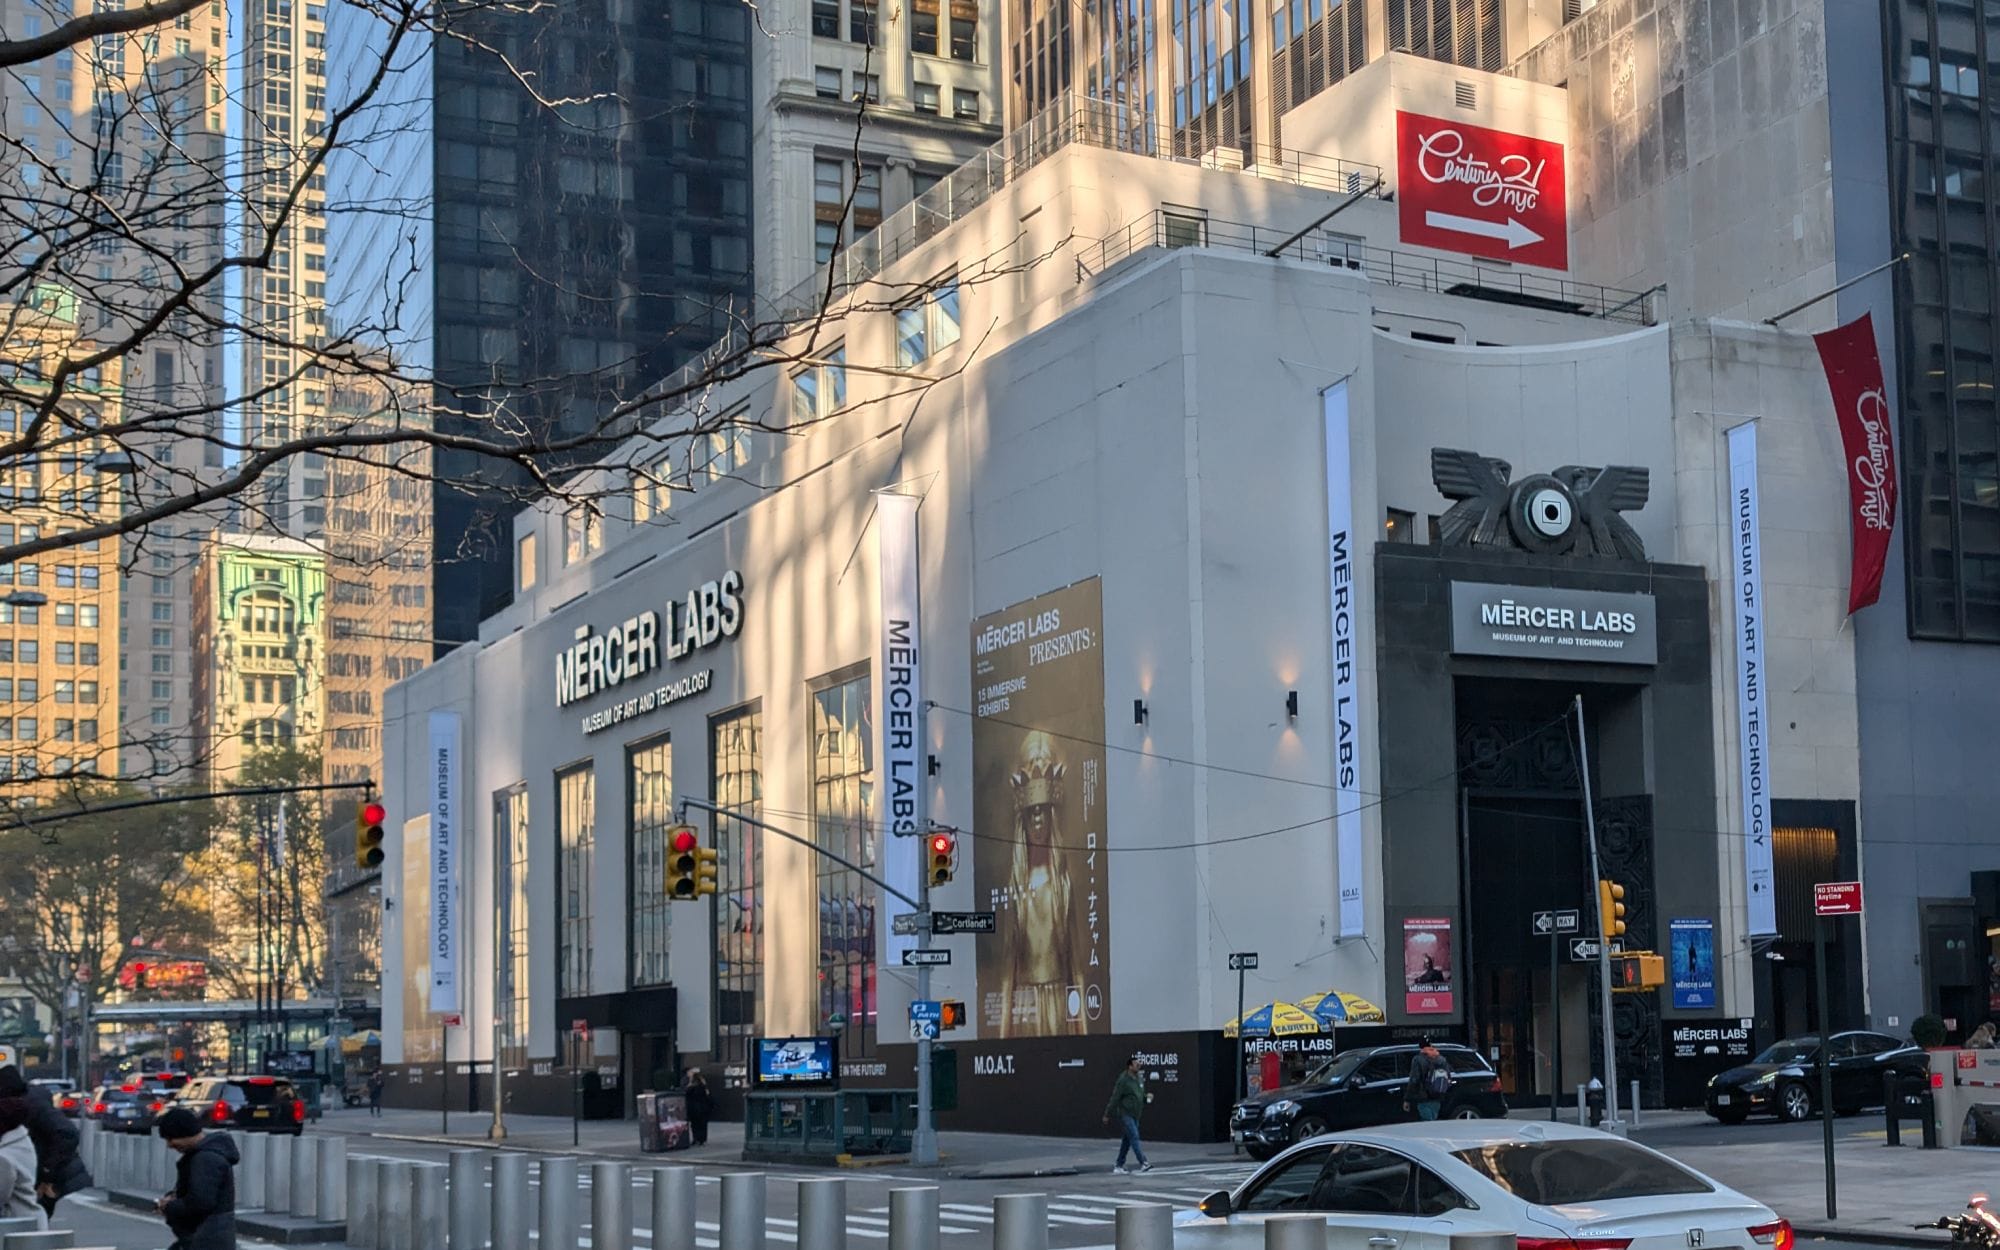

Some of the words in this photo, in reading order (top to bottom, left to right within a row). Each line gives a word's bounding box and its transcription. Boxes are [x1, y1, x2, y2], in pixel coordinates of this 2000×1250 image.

[1418, 129, 1503, 206] Century
[1500, 154, 1545, 188] 21
[1503, 188, 1536, 213] nyc
[1855, 387, 1889, 488] Century
[1860, 490, 1879, 528] nyc
[1740, 487, 1752, 576] MUSEUM
[1332, 530, 1351, 686] MĒRCER
[1743, 582, 1754, 608] OF
[1481, 599, 1575, 630] MĒRCER
[1581, 609, 1636, 633] LABS
[556, 610, 658, 708] MĒRCER
[666, 570, 742, 660] LABS
[976, 620, 1026, 656] MĒRCER
[1028, 608, 1060, 638] LABS
[1492, 632, 1526, 643] MUSEUM
[1527, 635, 1538, 643] OF
[1539, 636, 1554, 644] ART
[1557, 637, 1574, 645] AND
[1576, 638, 1624, 648] TECHNOLOGY
[1745, 615, 1756, 654] ART
[889, 619, 917, 750] MĒRCER
[978, 688, 986, 702] 15
[987, 676, 1027, 700] IMMERSIVE
[1746, 660, 1757, 702] AND
[582, 707, 612, 735] MUSEUM
[613, 703, 623, 723] OF
[623, 698, 638, 719] ART
[640, 692, 655, 714] AND
[656, 669, 710, 706] TECHNOLOGY
[978, 698, 1010, 717] EXHIBITS
[1337, 696, 1354, 789] LABS
[438, 747, 449, 800] MUSEUM
[1748, 709, 1764, 847] TECHNOLOGY
[438, 802, 449, 819] OF
[891, 760, 915, 839] LABS
[438, 822, 449, 845] ART
[438, 848, 449, 874] AND
[1827, 885, 1855, 893] STANDING
[438, 877, 449, 960] TECHNOLOGY
[952, 918, 987, 929] Cortlandt
[1558, 917, 1573, 927] WAY
[1579, 944, 1594, 954] ONE
[1088, 996, 1100, 1009] ML
[1301, 1038, 1333, 1051] LABS
[1673, 1027, 1719, 1041] MĒRCER
[1720, 1028, 1748, 1040] LABS
[850, 1064, 861, 1076] THE
[861, 1063, 887, 1077] FUTURE?
[974, 1055, 1015, 1075] M.O.A.T.
[1160, 1053, 1178, 1065] LABS
